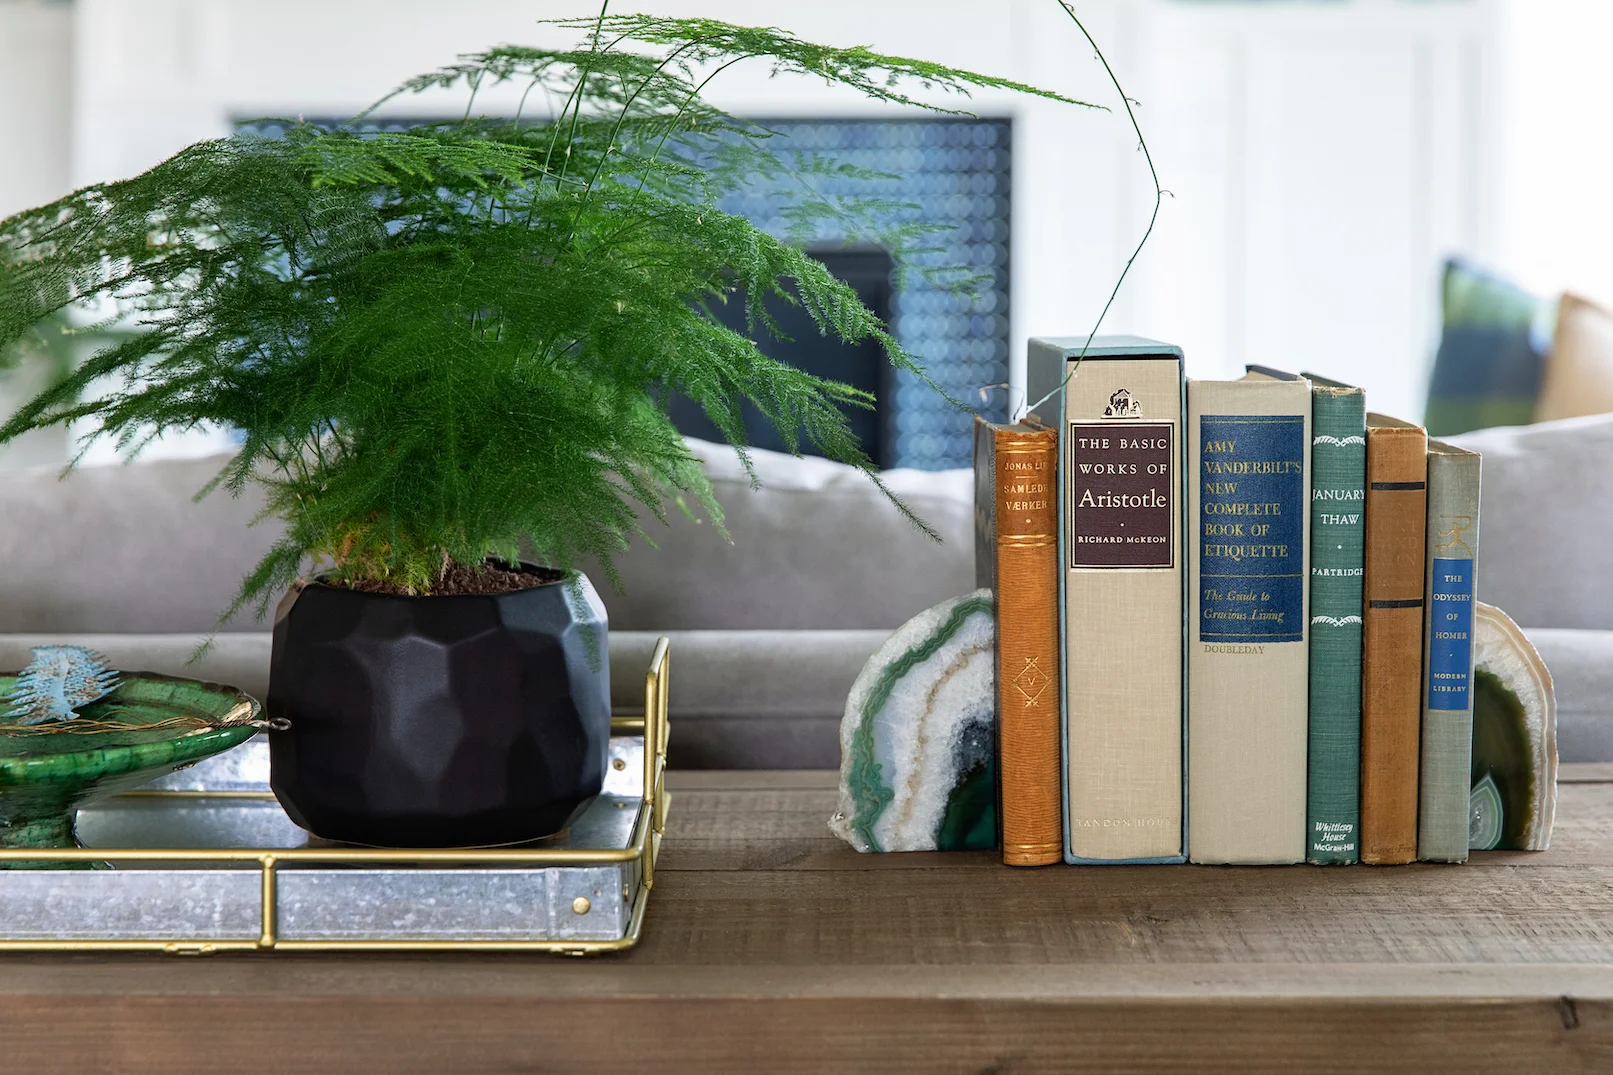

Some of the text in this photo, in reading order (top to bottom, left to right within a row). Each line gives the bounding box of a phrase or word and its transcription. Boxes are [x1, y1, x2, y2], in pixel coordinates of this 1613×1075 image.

[1078, 438, 1168, 449] THE BASIC
[1204, 440, 1237, 453] AMY
[1004, 462, 1033, 471] JONAS
[1078, 463, 1168, 475] WORKS OF
[1204, 461, 1303, 475] VANDERBILT'S
[1205, 482, 1238, 495] NEW
[1078, 488, 1168, 508] Aristotle
[1312, 488, 1365, 502] JANUARY
[1005, 500, 1048, 511] VÆRKER
[1204, 502, 1281, 516] COMPLETE
[1320, 513, 1360, 525] THAW
[1204, 523, 1270, 537] BOOK OF
[1077, 535, 1167, 544] RICHARD McKEON
[1204, 544, 1289, 562] ETIQUETTE
[1444, 575, 1463, 583] THE
[1204, 589, 1271, 602] The Guide to
[1433, 593, 1472, 602] ODYSSEY
[1249, 608, 1285, 624] Living
[1446, 613, 1459, 621] OF
[1435, 631, 1468, 640] HOMER
[1203, 644, 1266, 655] DOUBLEDAY
[1027, 677, 1036, 686] V
[1433, 685, 1467, 693] LIBRARY
[1321, 832, 1347, 842] House
